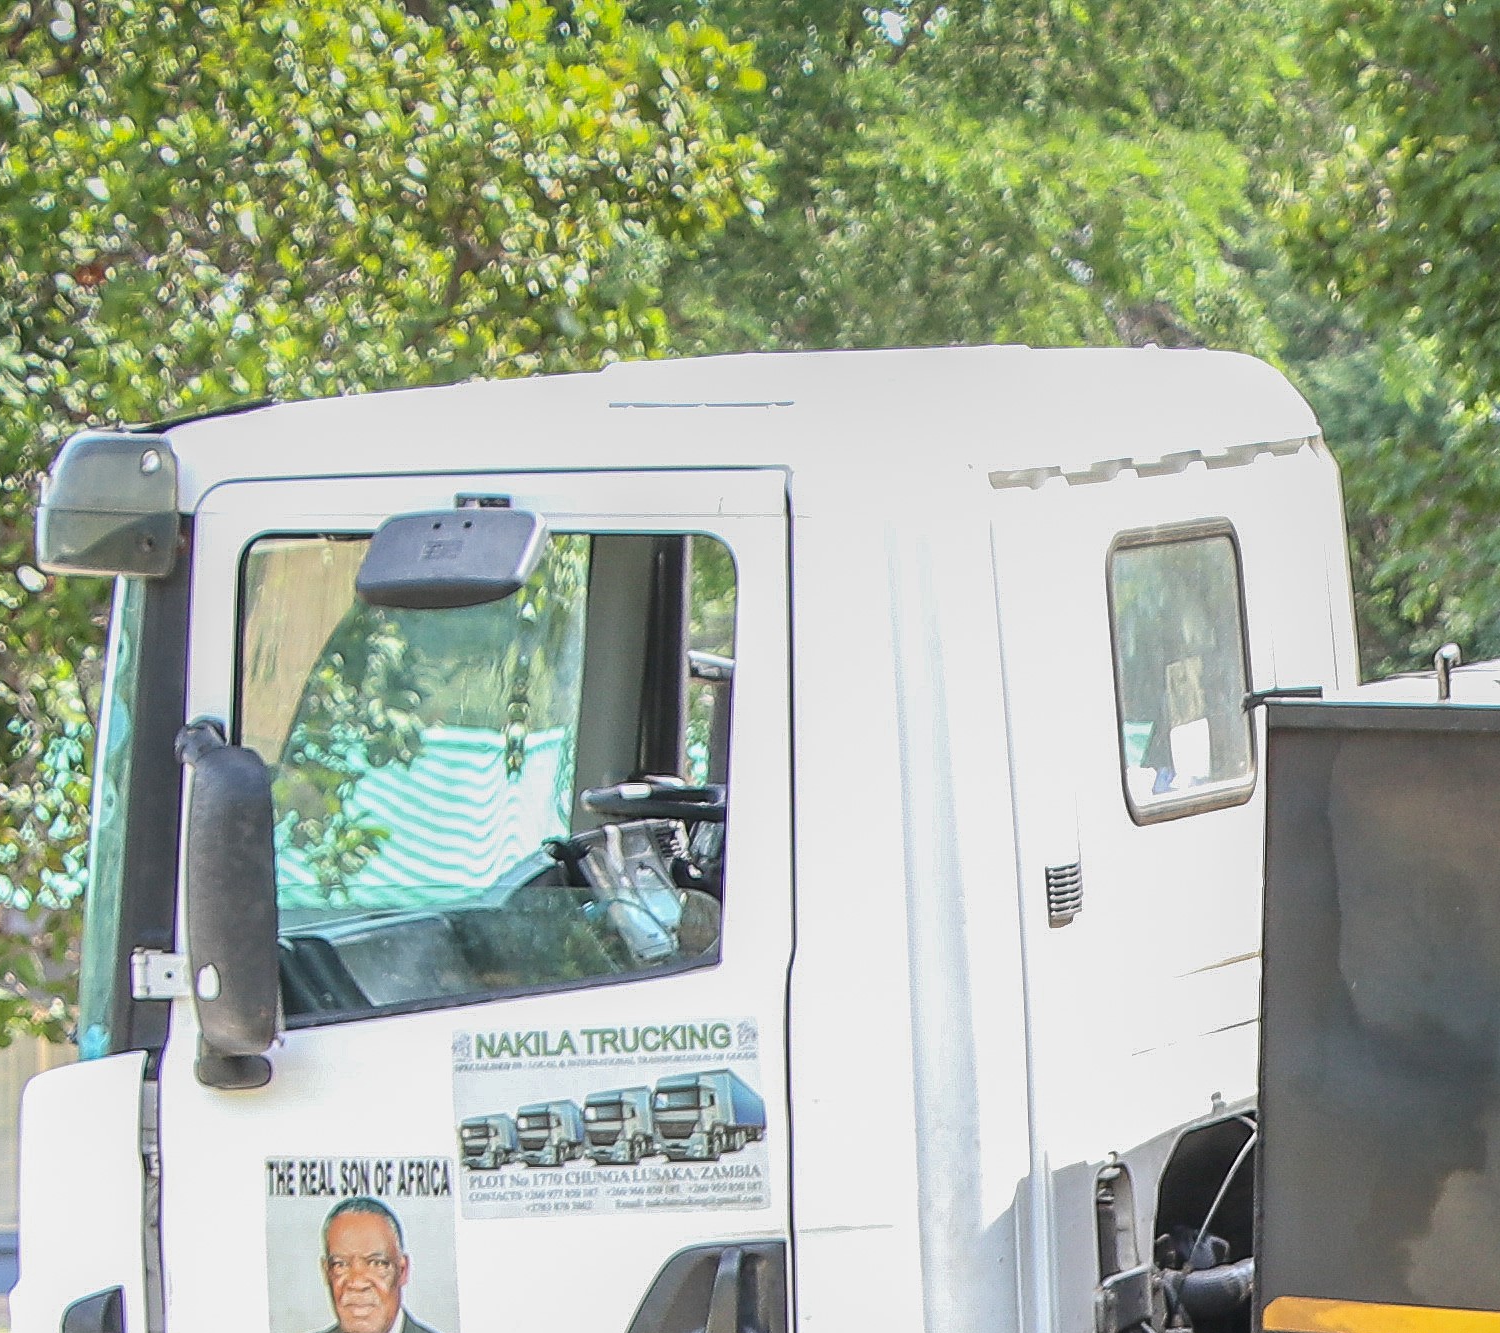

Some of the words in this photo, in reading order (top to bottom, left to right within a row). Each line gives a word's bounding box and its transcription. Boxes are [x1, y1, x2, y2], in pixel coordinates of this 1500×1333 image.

[475, 1030, 577, 1059] NAKILA
[580, 1022, 733, 1055] TRUCKING
[267, 1160, 295, 1196] THE
[299, 1160, 336, 1196] REAL
[340, 1160, 370, 1196] SON
[374, 1160, 393, 1196] OF
[397, 1160, 451, 1196] AFRICA
[701, 1164, 761, 1179] ZAMBIA
